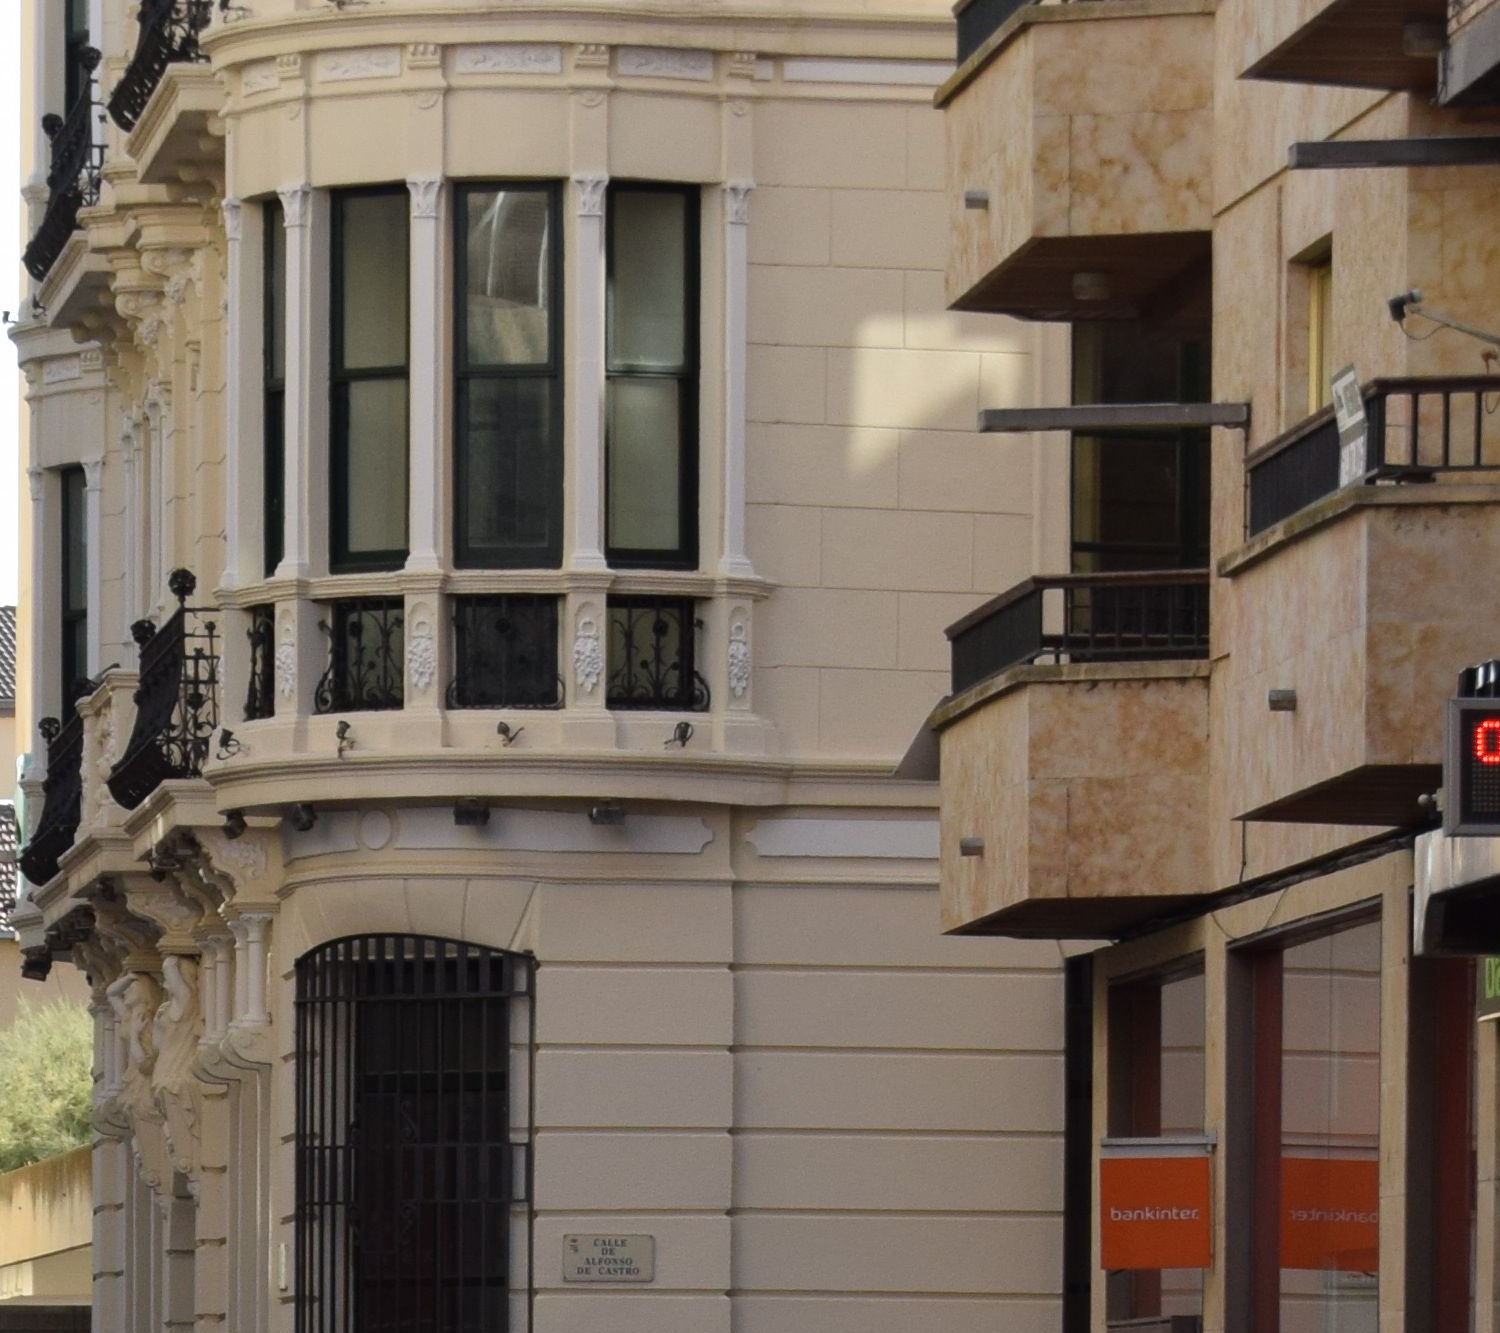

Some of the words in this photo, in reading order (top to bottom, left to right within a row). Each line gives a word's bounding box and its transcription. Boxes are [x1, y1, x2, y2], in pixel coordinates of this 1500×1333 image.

[593, 1238, 628, 1248] CALLE
[601, 1248, 616, 1256] DE
[584, 1257, 633, 1266] ALFONSO
[576, 1267, 592, 1275] DE
[598, 1267, 640, 1275] CASTRO
